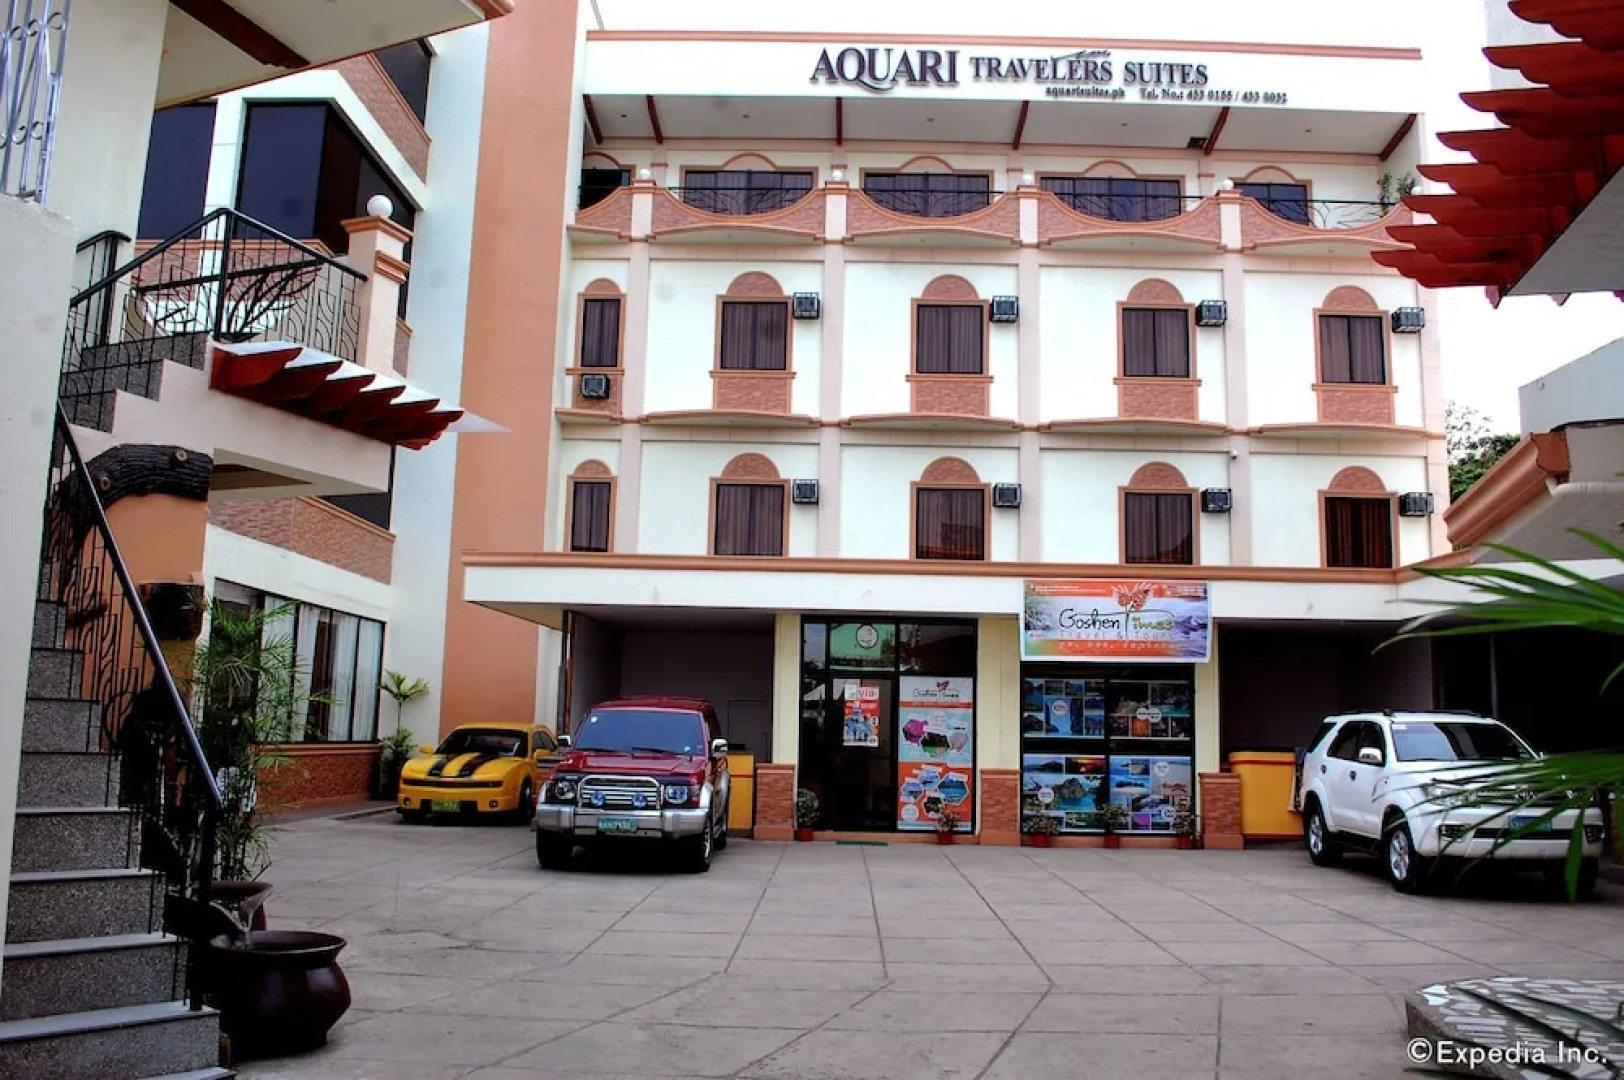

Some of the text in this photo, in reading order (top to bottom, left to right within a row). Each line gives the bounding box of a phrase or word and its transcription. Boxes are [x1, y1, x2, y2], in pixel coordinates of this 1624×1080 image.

[809, 47, 1209, 91] AQUARI TRAVELERS SUITES
[1059, 608, 1120, 630] Goshen
